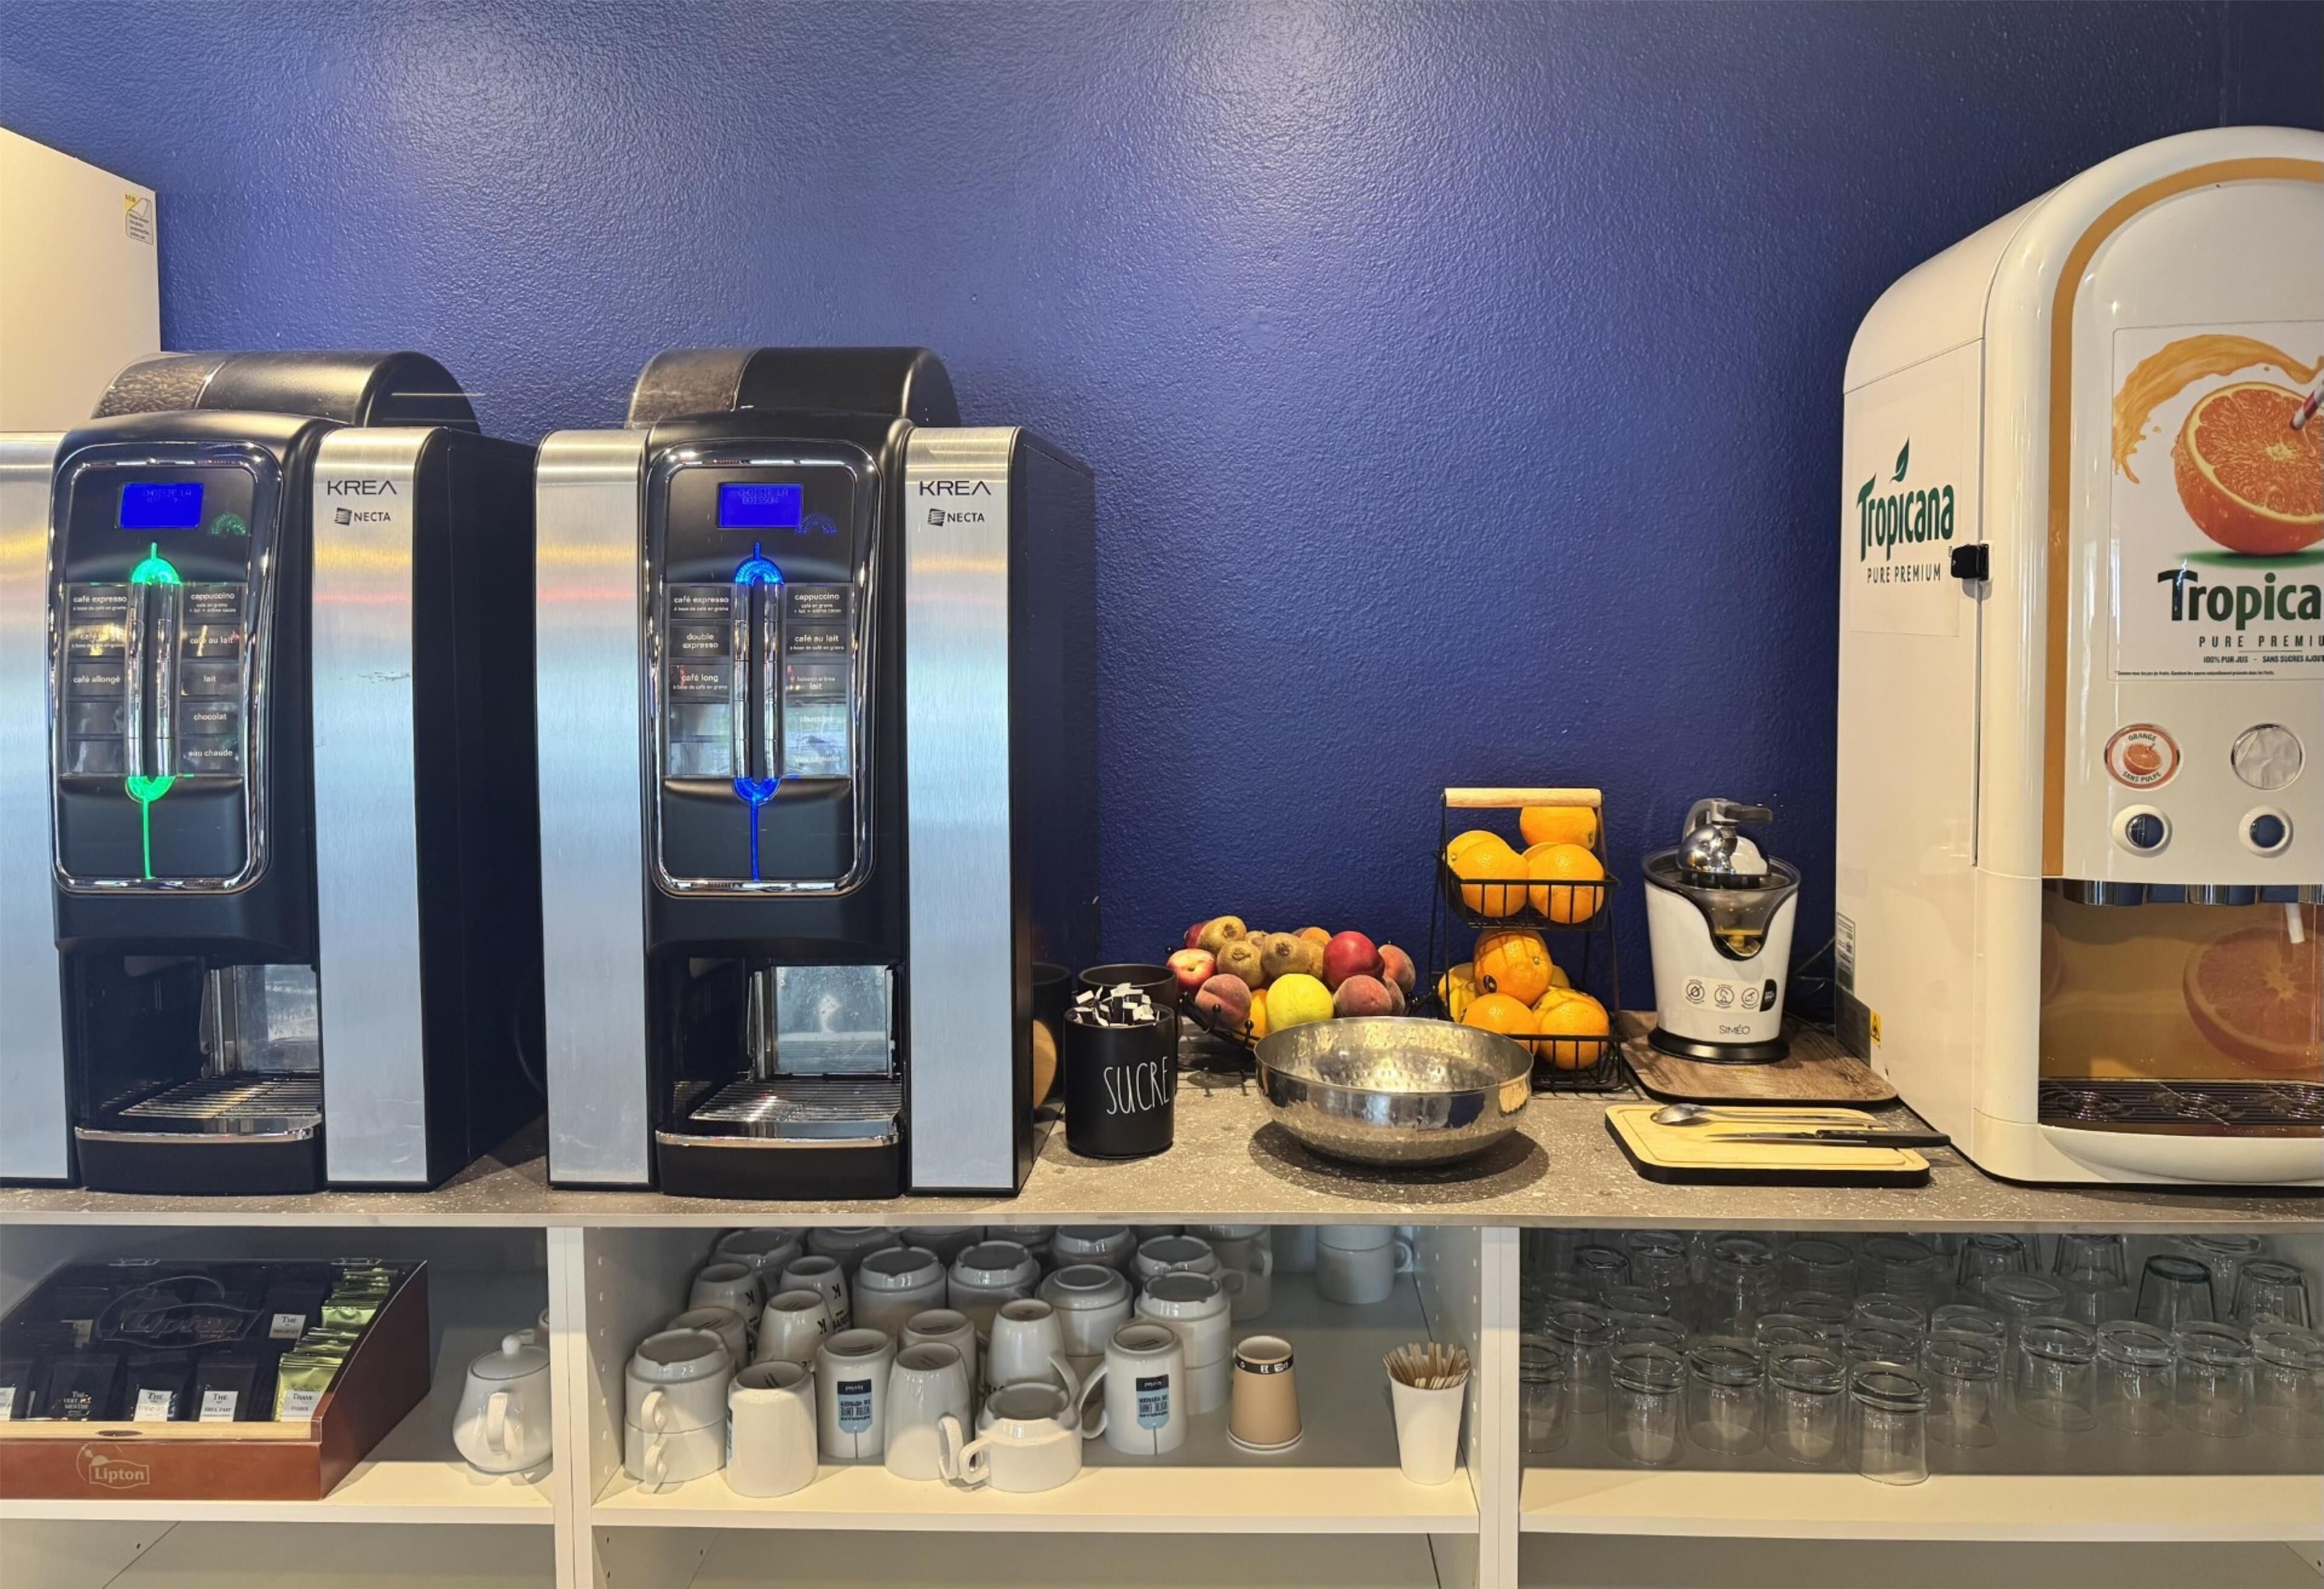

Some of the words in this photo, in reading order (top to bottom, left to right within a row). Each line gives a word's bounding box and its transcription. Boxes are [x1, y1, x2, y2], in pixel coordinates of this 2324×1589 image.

[327, 480, 398, 496] KREA
[919, 480, 992, 496] KREA
[354, 512, 391, 522] NECTA
[947, 512, 985, 522] NECTA
[1857, 472, 1954, 562] Tropicana
[1868, 567, 1890, 584] PURE
[1895, 563, 1941, 582] PREMIUM
[795, 592, 840, 602] cappuccino
[2158, 569, 2322, 631] Tropica
[795, 634, 812, 642] café
[2199, 636, 2244, 647] PURE
[2258, 634, 2324, 646] PREMIU
[91, 675, 120, 684] allongé
[682, 673, 699, 682] café
[701, 673, 719, 682] long
[2128, 732, 2157, 742] ORANGE
[2122, 771, 2139, 782] SANS
[2140, 771, 2161, 783] PULPE
[1719, 1024, 1751, 1035] SIMÉO
[1104, 1056, 1170, 1114] SUCRE
[95, 1467, 144, 1484] Lipton
